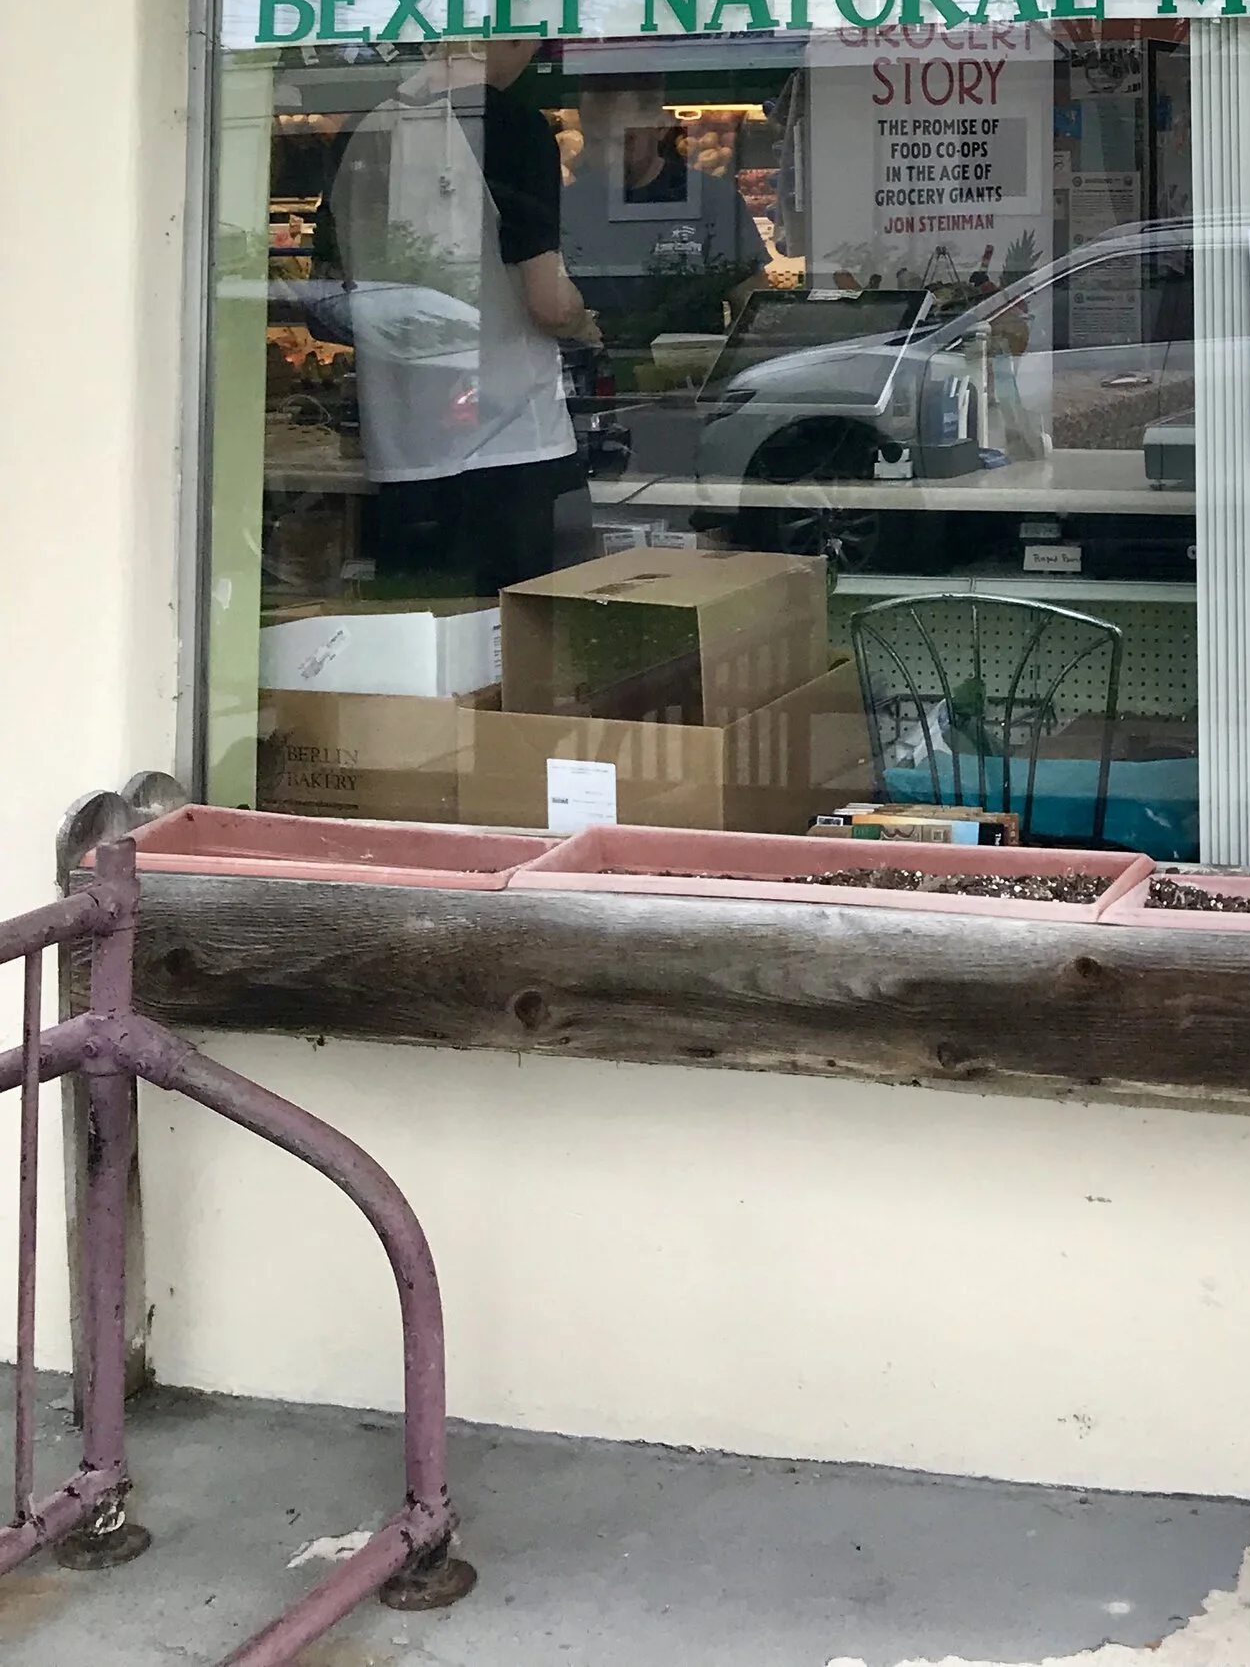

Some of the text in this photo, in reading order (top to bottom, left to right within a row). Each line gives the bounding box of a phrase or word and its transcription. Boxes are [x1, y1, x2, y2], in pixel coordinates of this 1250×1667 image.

[871, 56, 1007, 106] STORY
[878, 118, 1000, 136] THE PROMISE OF
[890, 141, 988, 159] FOOD CO-OPS
[886, 163, 993, 183] IN THE AGE OF
[874, 186, 1003, 207] GROCERY GIANTS
[884, 213, 995, 234] JON STEINMAN
